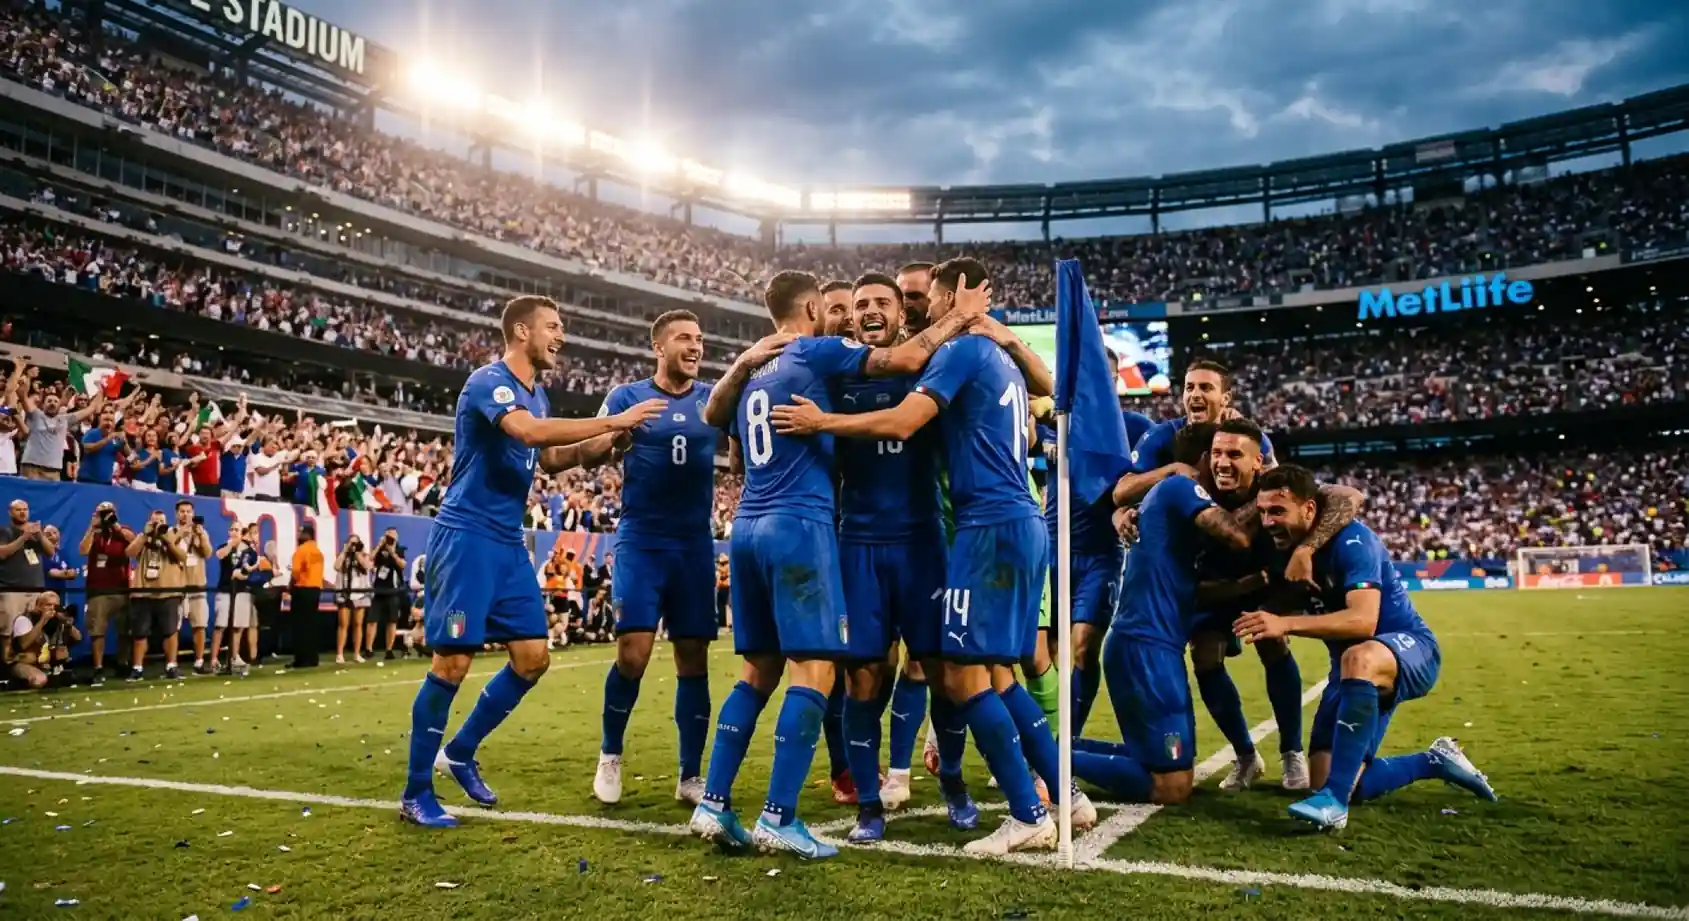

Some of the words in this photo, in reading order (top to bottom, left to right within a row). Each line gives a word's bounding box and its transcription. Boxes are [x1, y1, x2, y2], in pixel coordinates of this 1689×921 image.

[222, 0, 365, 74] STADIUM
[1357, 272, 1533, 320] MetLiife
[672, 434, 687, 465] 8
[746, 388, 773, 466] 8
[999, 382, 1028, 463] 14
[943, 588, 970, 626] 14
